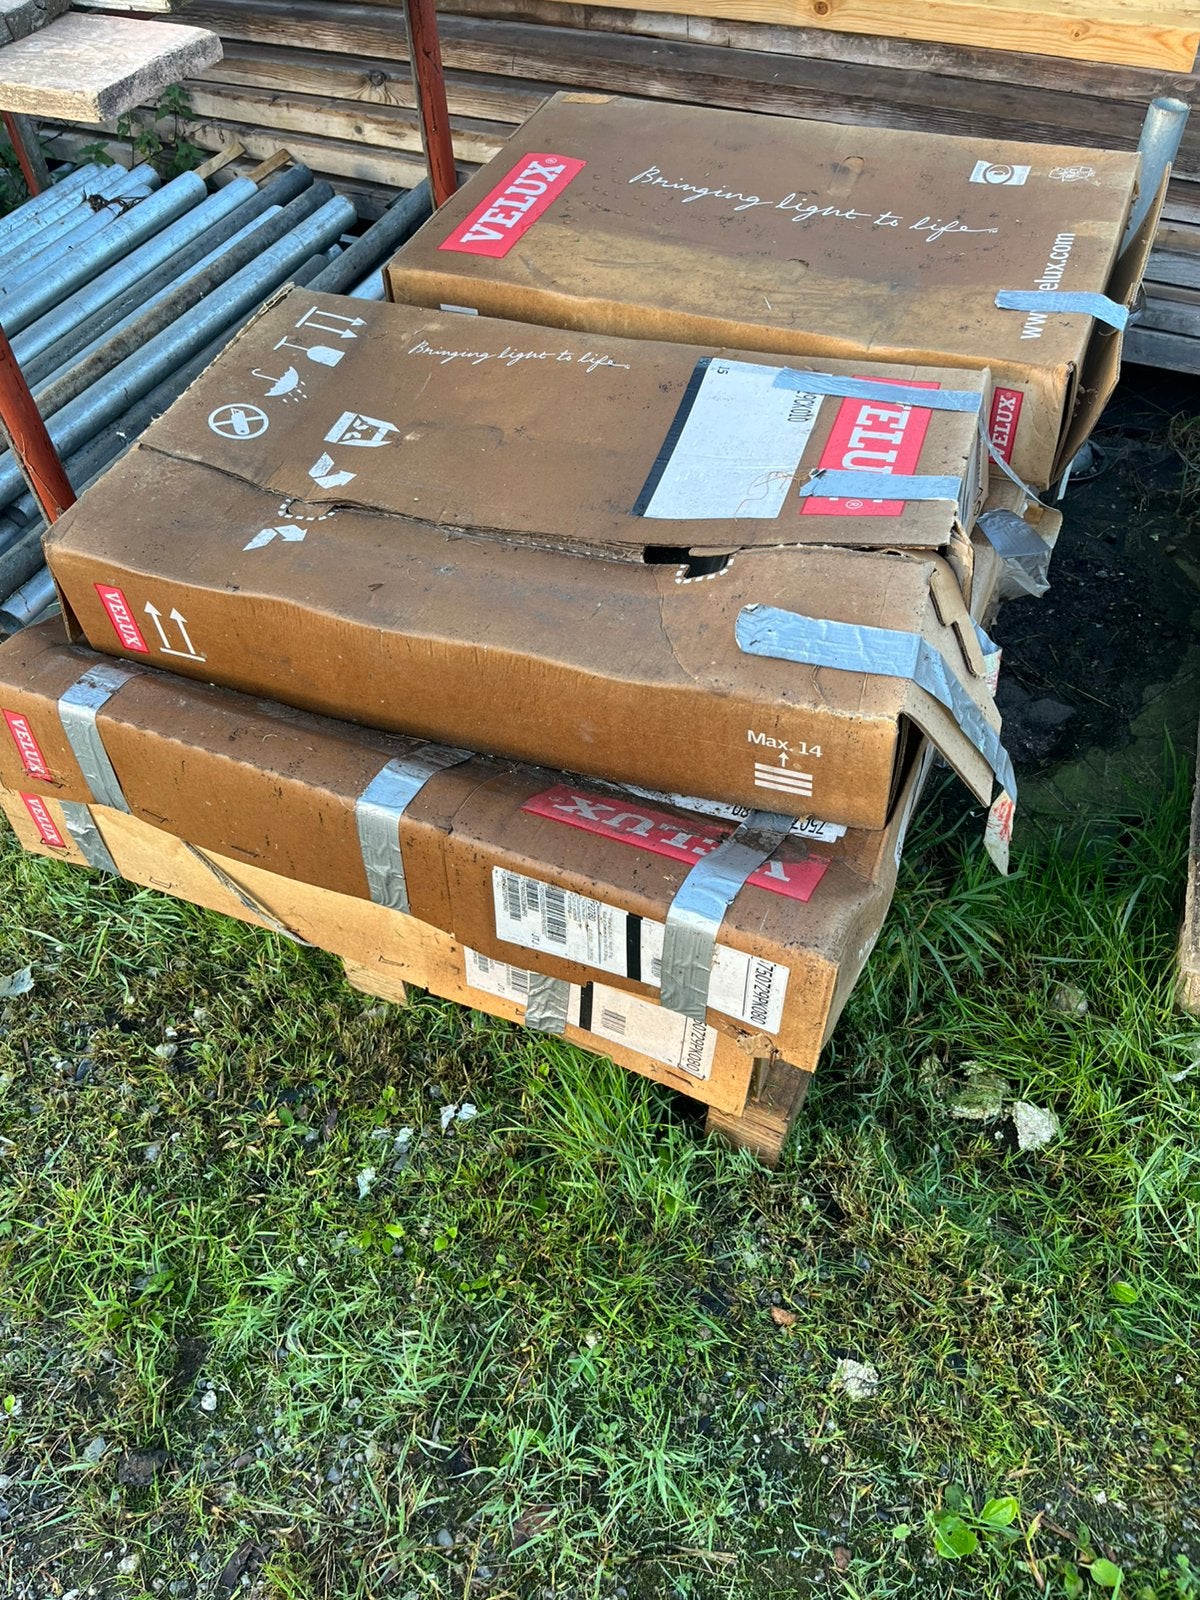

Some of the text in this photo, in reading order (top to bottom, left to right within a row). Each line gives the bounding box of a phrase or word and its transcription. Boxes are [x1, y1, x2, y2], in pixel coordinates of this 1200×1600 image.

[628, 165, 773, 211] Bringing
[775, 192, 872, 222] light
[873, 210, 903, 227] to
[407, 339, 497, 365] Bringing
[497, 346, 556, 367] light
[556, 349, 575, 361] to
[828, 402, 912, 503] ELU
[104, 592, 142, 647] VELUX
[746, 729, 823, 758] Max. 14
[28, 798, 60, 844] VELUX
